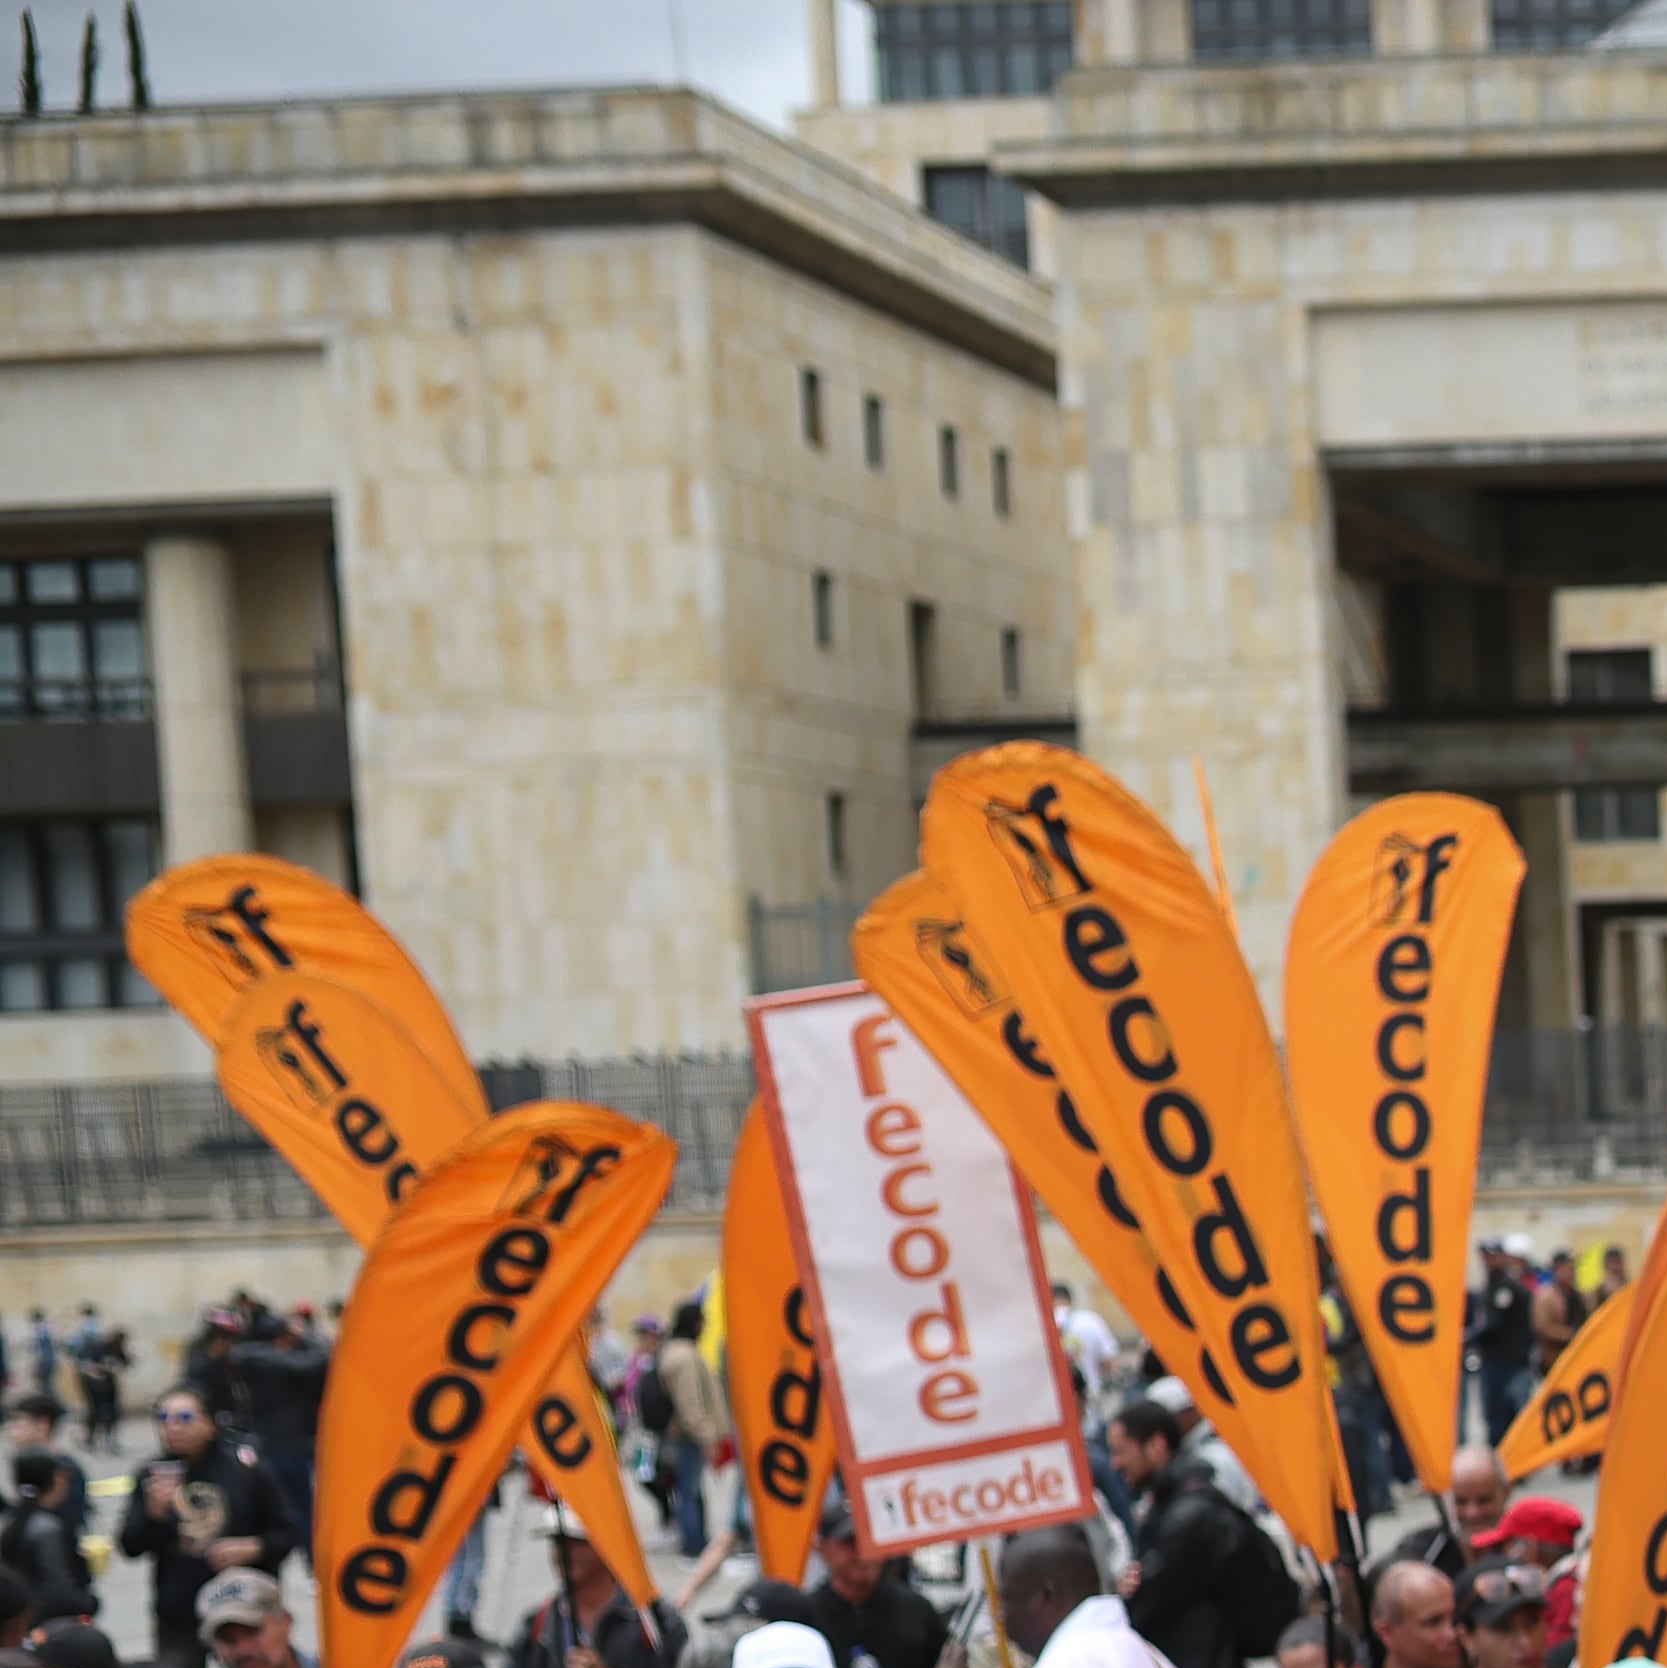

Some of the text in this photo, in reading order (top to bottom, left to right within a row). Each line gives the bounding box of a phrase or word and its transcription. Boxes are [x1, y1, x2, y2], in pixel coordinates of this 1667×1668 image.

[851, 1012, 981, 1425] fecode
[1027, 785, 1303, 1390] fecode
[1373, 835, 1461, 1345] fecode
[341, 1145, 623, 1615] fecode
[900, 1458, 1066, 1529] fecode
